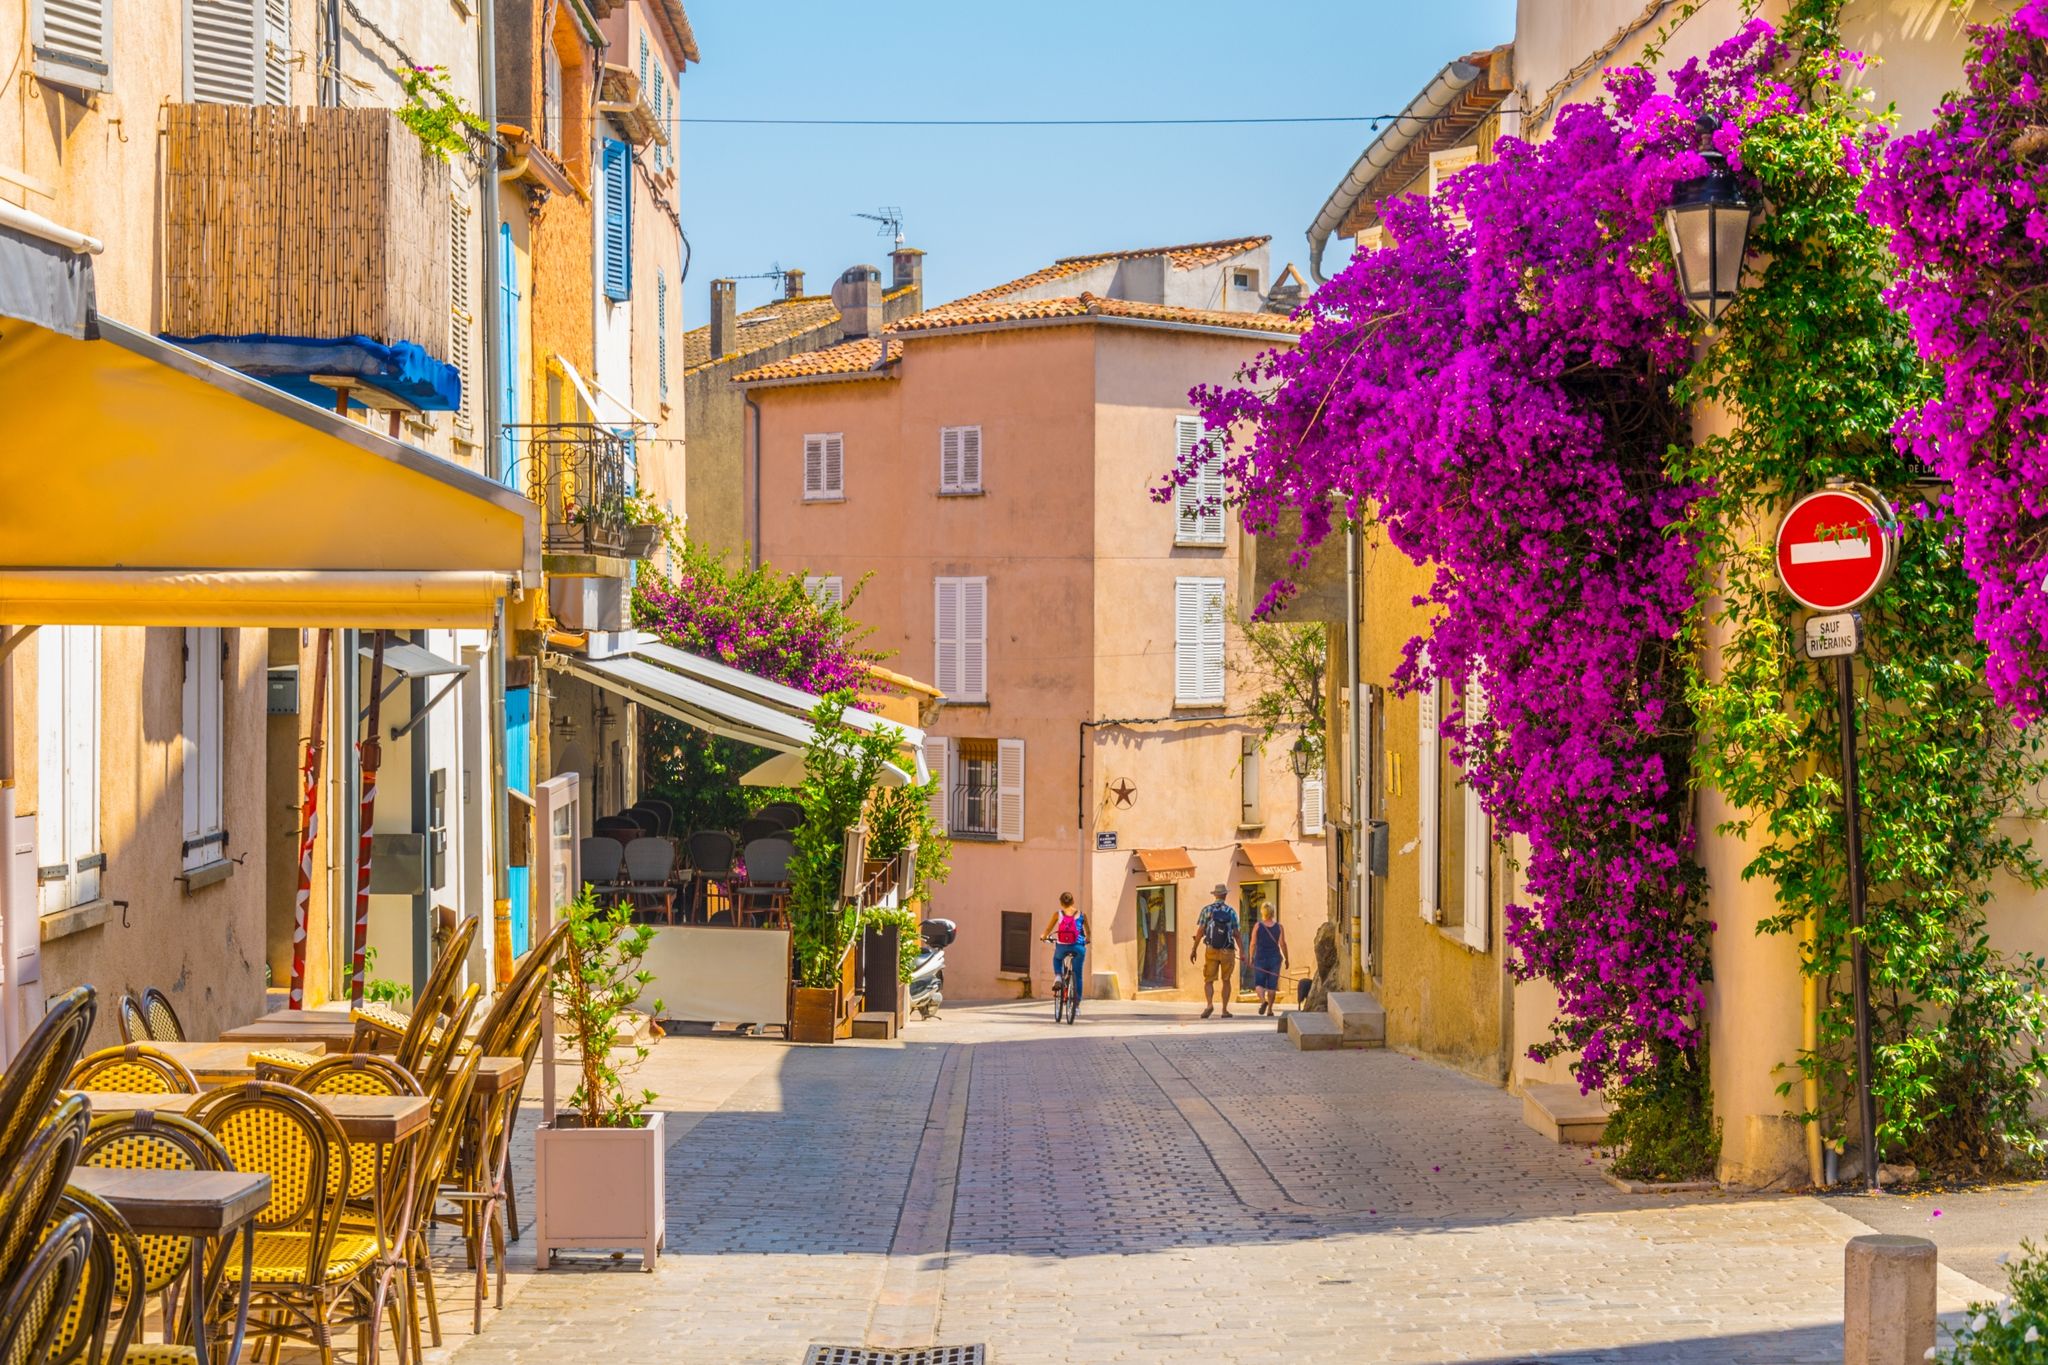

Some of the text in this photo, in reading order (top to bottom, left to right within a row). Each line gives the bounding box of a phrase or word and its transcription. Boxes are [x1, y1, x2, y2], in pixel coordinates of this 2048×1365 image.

[1908, 464, 1919, 473] DE
[1820, 620, 1840, 634] SAUF
[1810, 635, 1852, 652] RIVERAINS
[1154, 870, 1190, 881] BATTAGLIA
